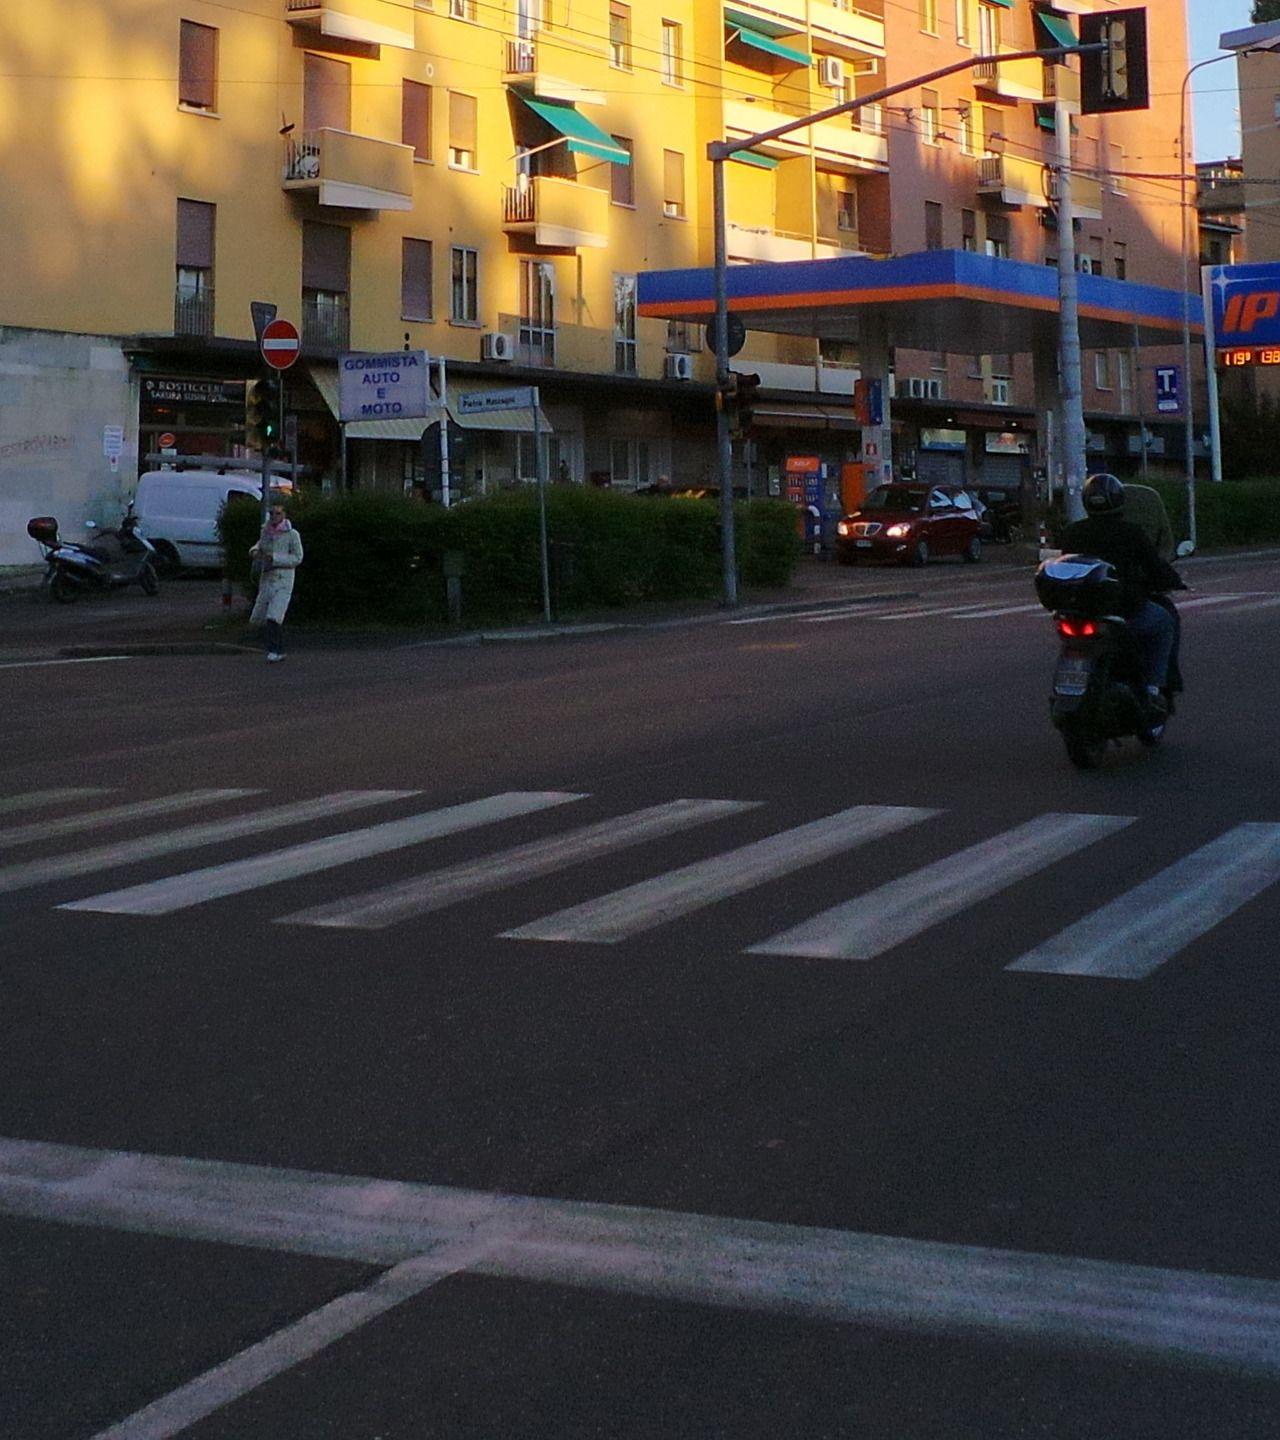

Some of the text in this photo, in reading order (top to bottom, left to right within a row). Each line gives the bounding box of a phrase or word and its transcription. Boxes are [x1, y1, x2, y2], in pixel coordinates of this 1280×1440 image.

[1222, 291, 1280, 333] IP
[344, 356, 418, 371] GOMMISTA
[362, 372, 401, 385] AUTO
[376, 388, 386, 399] E
[361, 402, 402, 415] MOTO
